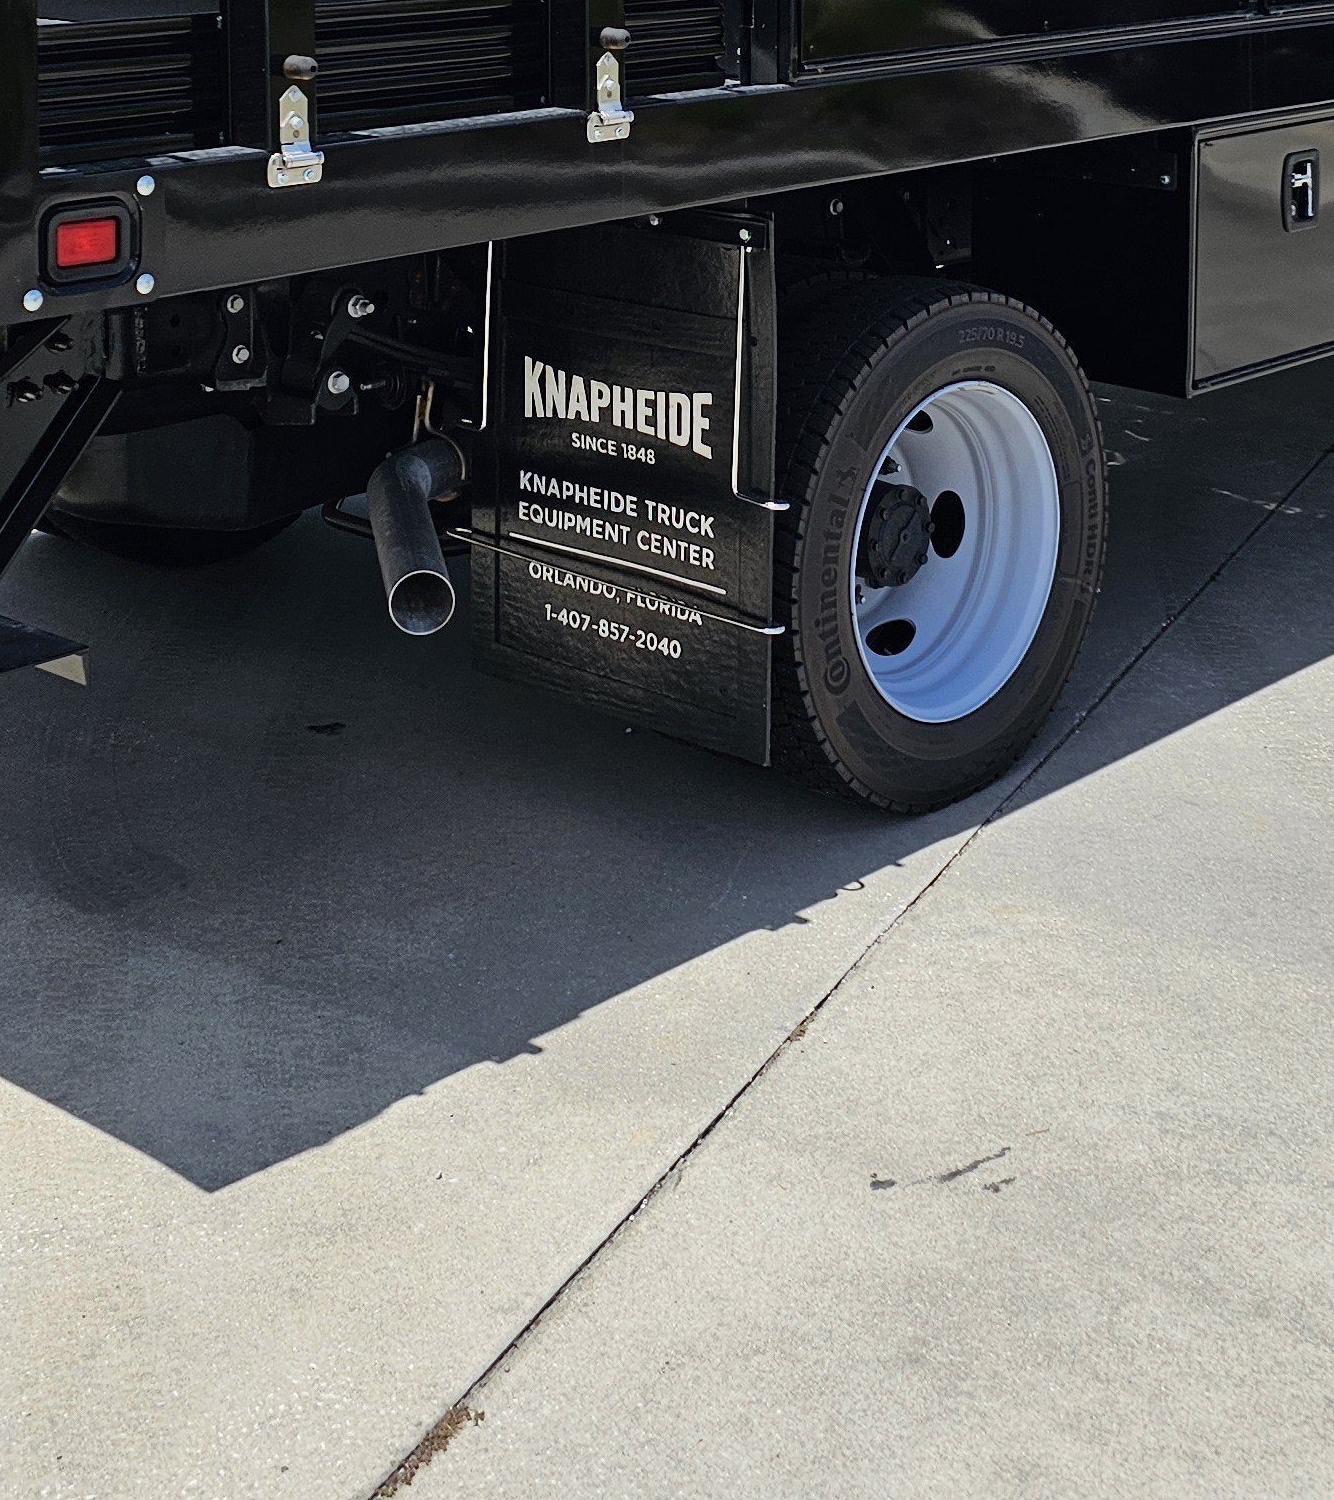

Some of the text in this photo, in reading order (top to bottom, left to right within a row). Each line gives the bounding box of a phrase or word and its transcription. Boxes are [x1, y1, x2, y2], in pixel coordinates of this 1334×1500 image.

[524, 355, 713, 460] KNAPHEIDE
[571, 432, 656, 465] SINCE 1848
[518, 501, 716, 570] EQUIPMENT CENTER
[519, 470, 716, 539] KNAPHEIDE TRUCK
[528, 562, 703, 626] ORLANDO, FLORIDA
[544, 603, 682, 659] 1-407-857-2040
